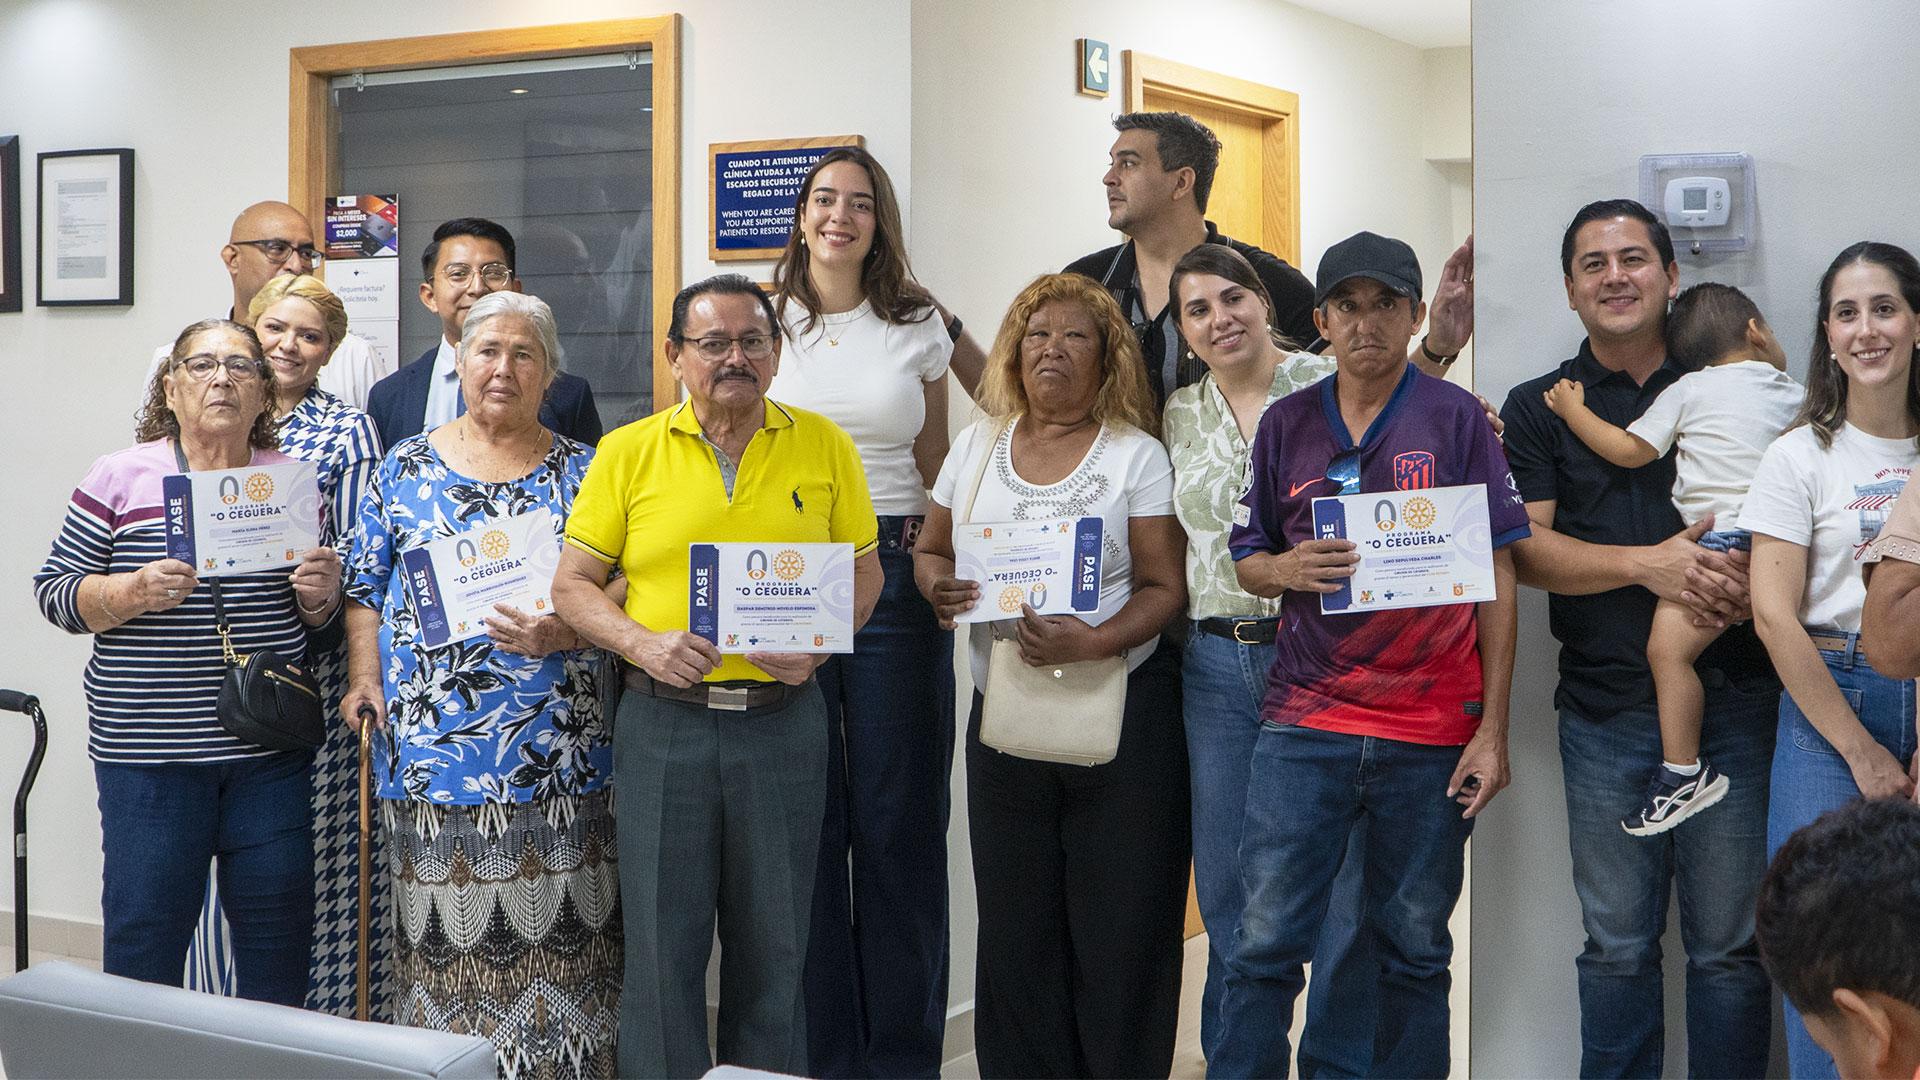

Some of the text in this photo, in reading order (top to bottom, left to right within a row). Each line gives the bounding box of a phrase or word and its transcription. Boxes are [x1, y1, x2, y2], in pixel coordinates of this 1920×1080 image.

[728, 159, 760, 168] CUANDO
[772, 156, 807, 166] ATIENDES
[809, 156, 820, 164] EN
[723, 166, 813, 179] CLÍNICA AYUDAS A PACI
[726, 179, 759, 189] ESCASOS
[761, 178, 800, 187] RECURSOS
[743, 189, 772, 198] REGALO
[785, 188, 795, 196] LA
[722, 207, 795, 218] WHEN YOU ARE CARED
[726, 217, 795, 227] YOU ARE SUPPORTING
[720, 228, 748, 237] PATIENTS
[760, 226, 788, 235] RESTORE
[1874, 468, 1891, 480] BON
[170, 497, 184, 536] PASE
[1386, 530, 1431, 538] PROGRAMA
[1082, 556, 1096, 591] PASE
[413, 569, 433, 607] PASE
[696, 568, 708, 607] PASE
